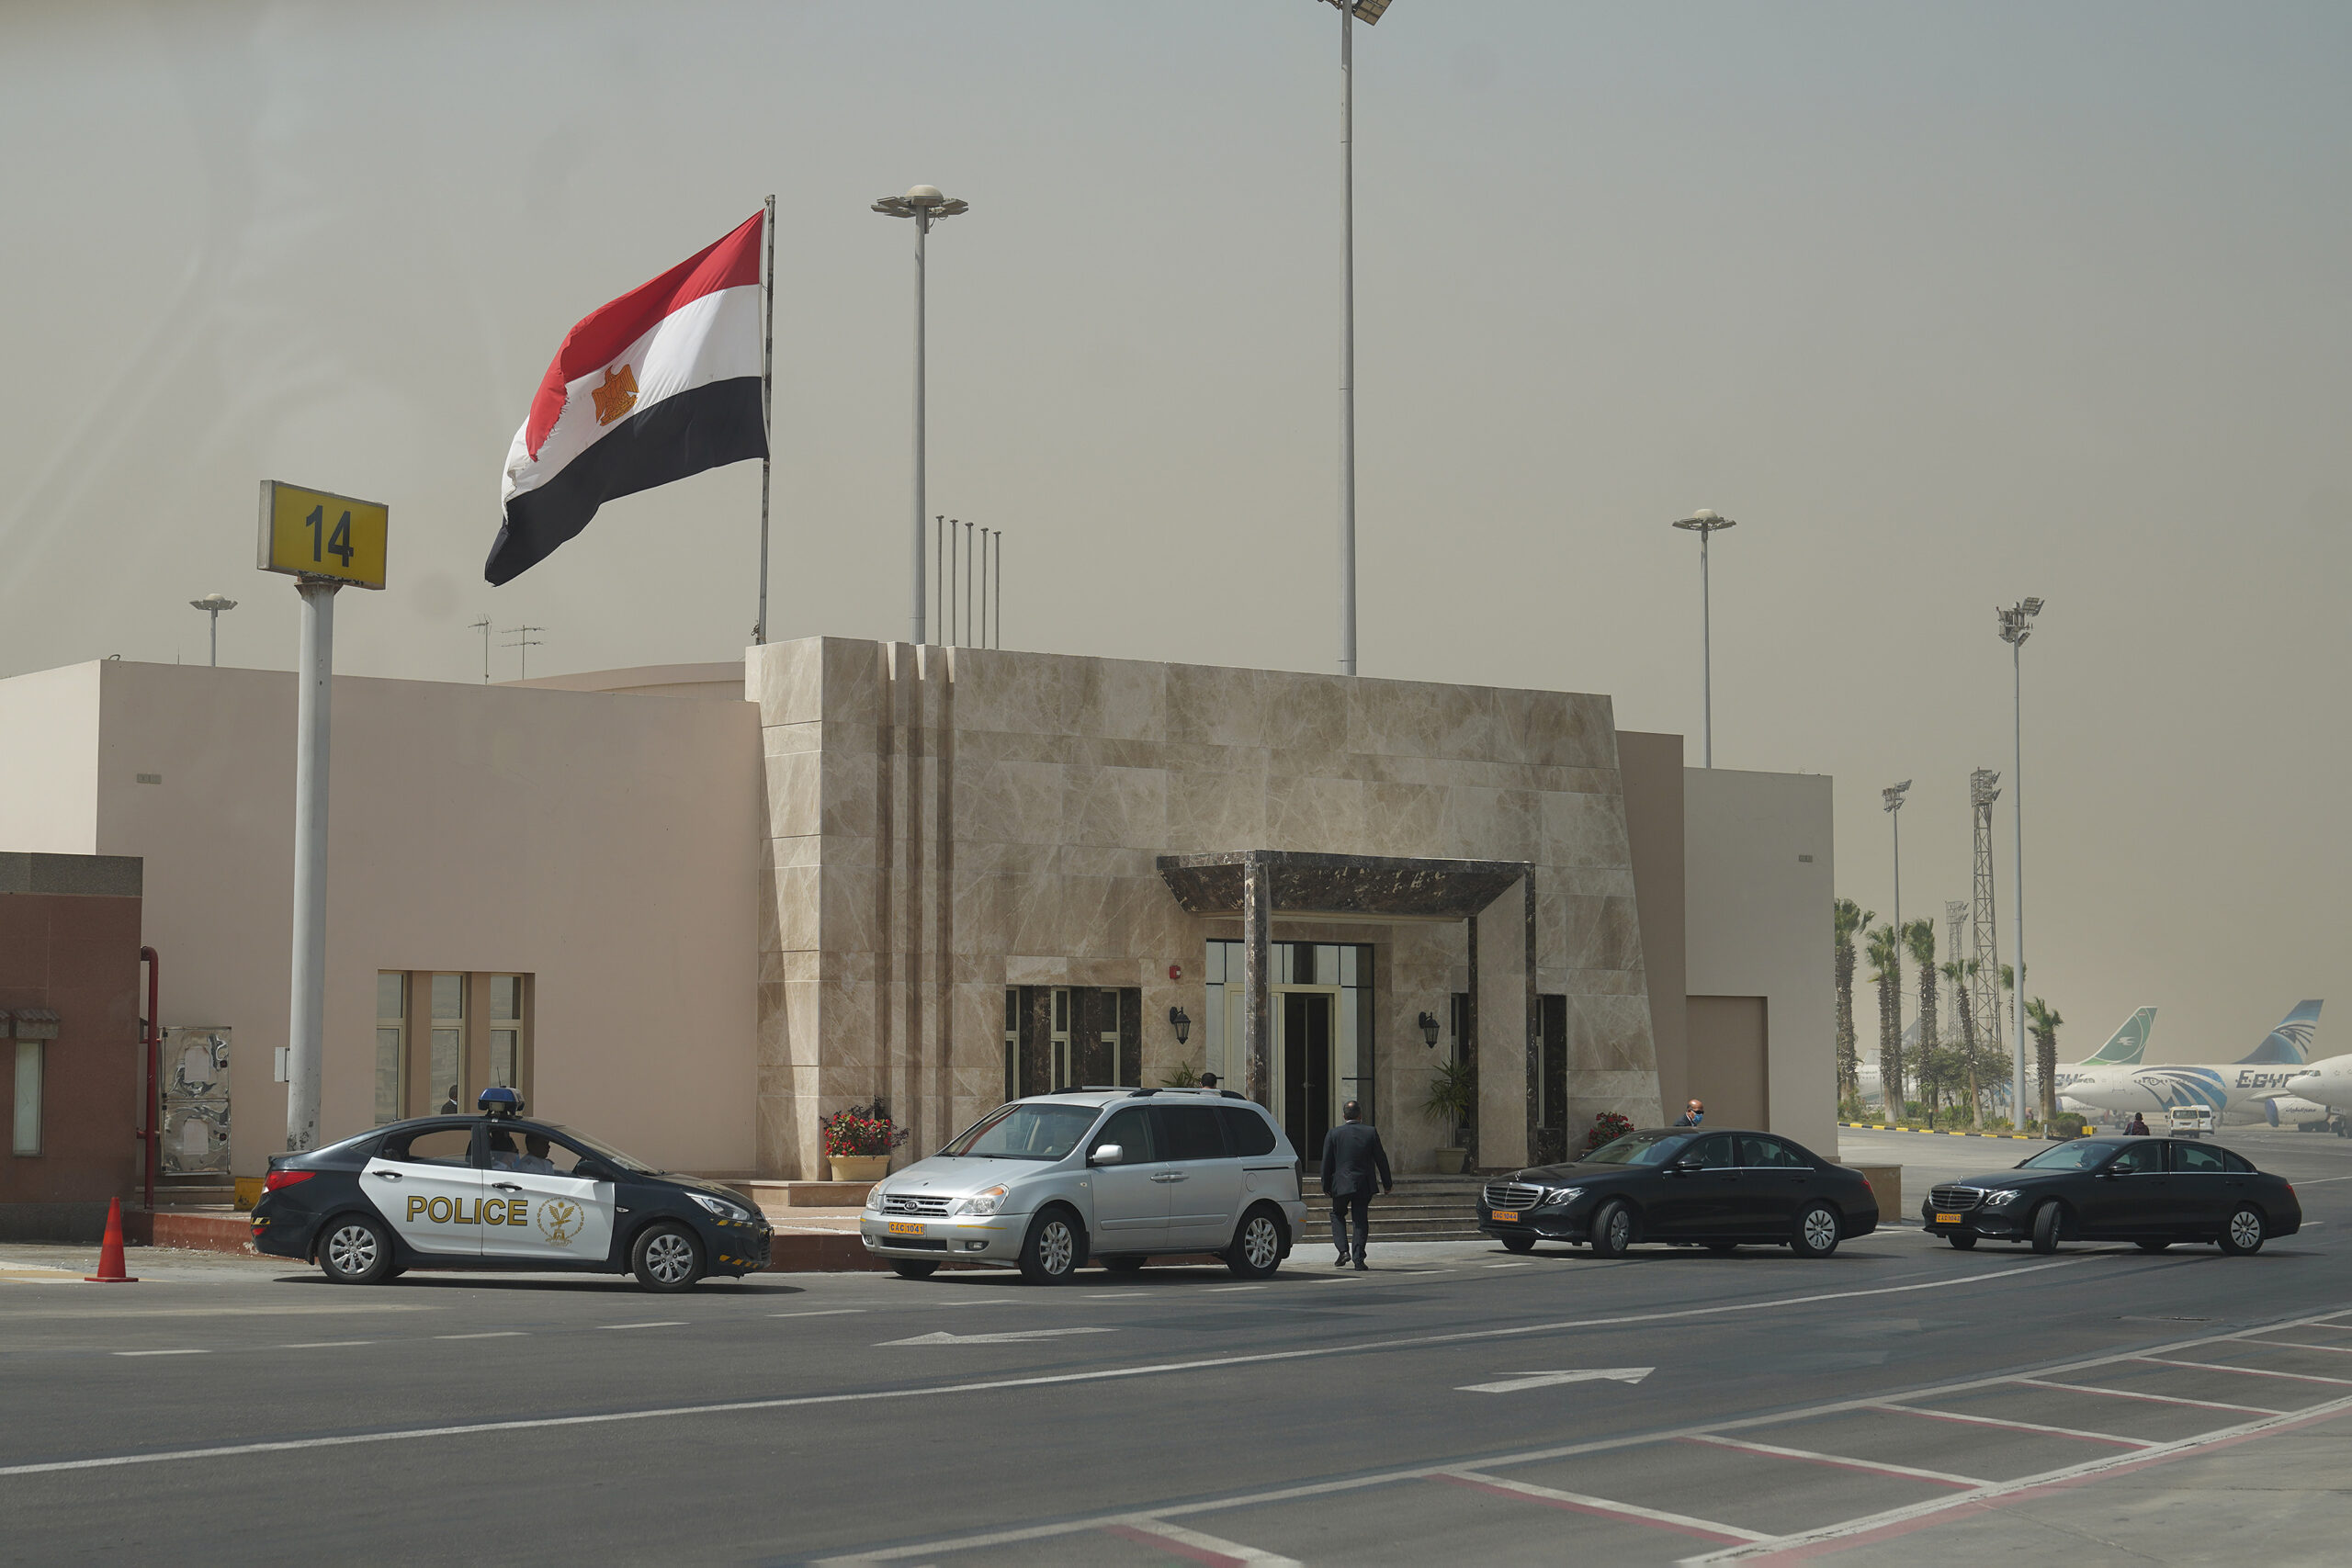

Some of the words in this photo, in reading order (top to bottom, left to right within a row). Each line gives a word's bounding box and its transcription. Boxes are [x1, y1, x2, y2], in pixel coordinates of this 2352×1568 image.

[306, 504, 355, 568] 14
[406, 1195, 529, 1226] POLICE
[890, 1224, 905, 1232] CAC
[907, 1224, 923, 1233] 1041
